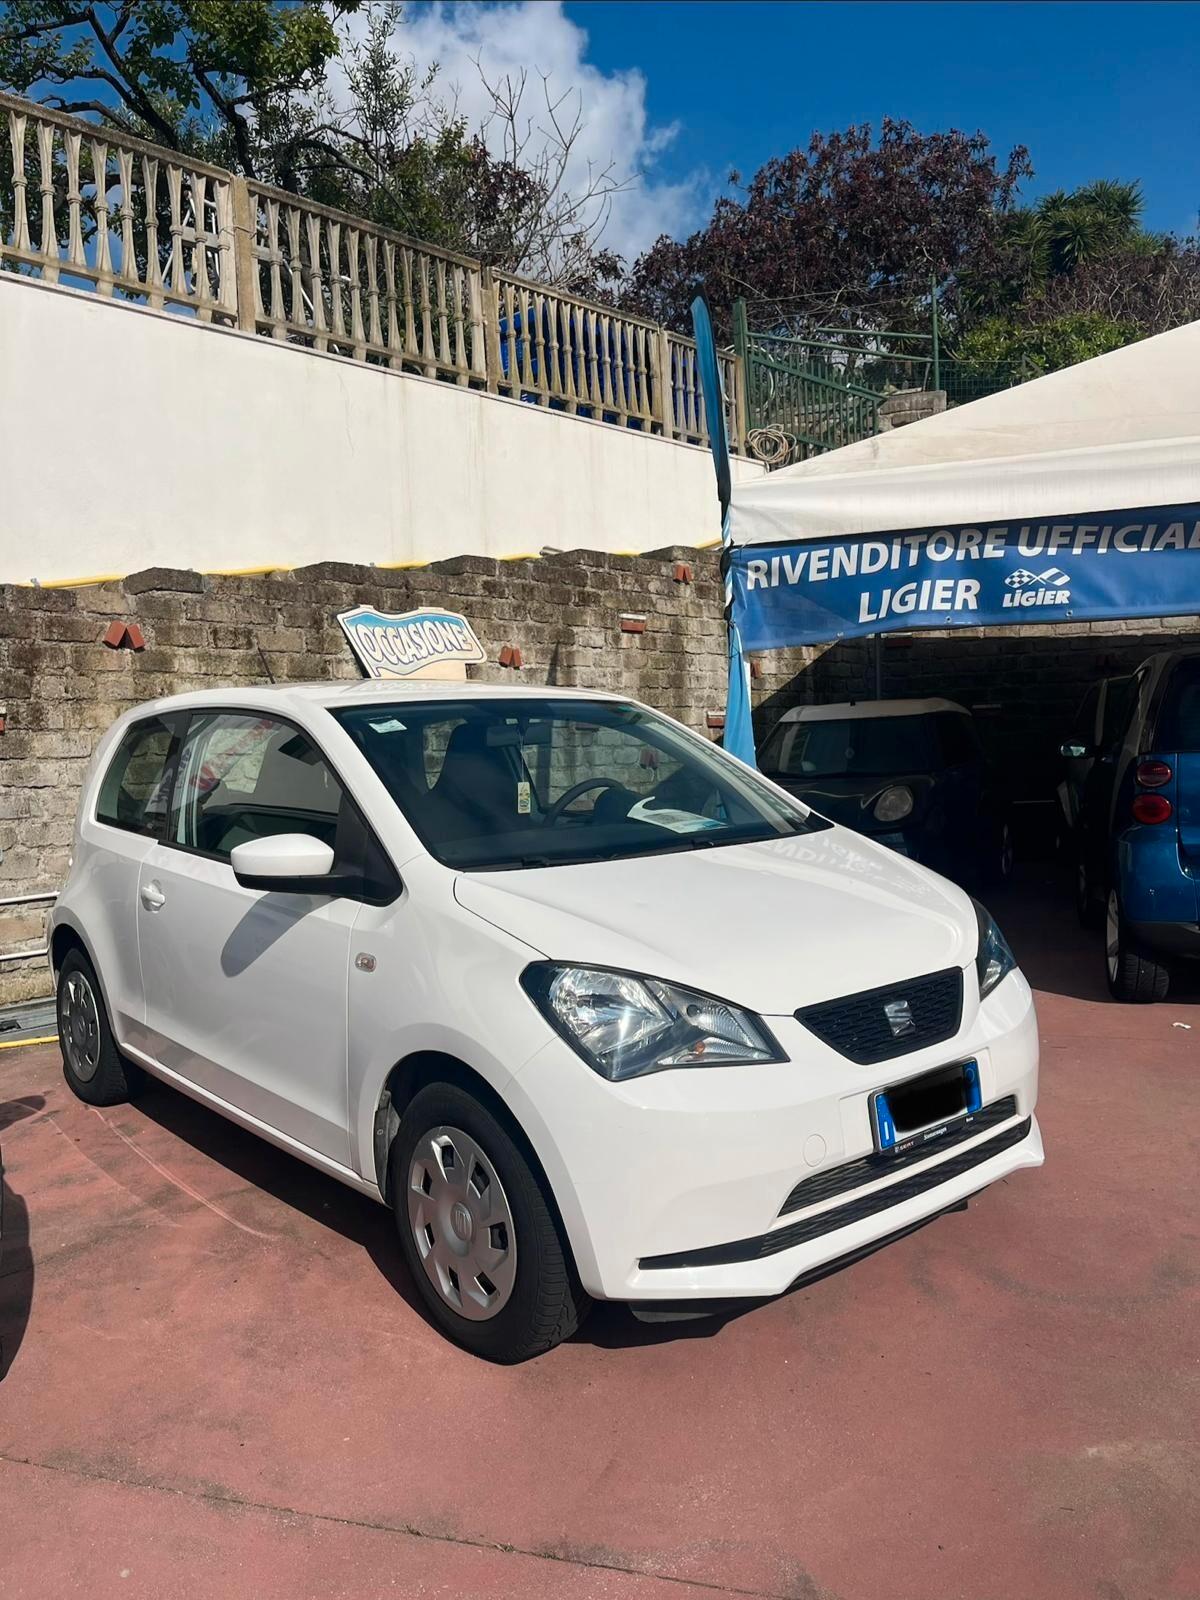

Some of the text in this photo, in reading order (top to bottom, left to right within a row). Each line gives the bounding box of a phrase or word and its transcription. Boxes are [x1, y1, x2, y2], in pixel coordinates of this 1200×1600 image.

[747, 527, 1009, 591] RIVENDITORE
[858, 578, 981, 624] LIGIER
[1002, 587, 1071, 608] LIGIER
[355, 620, 473, 665] OCCASIONE
